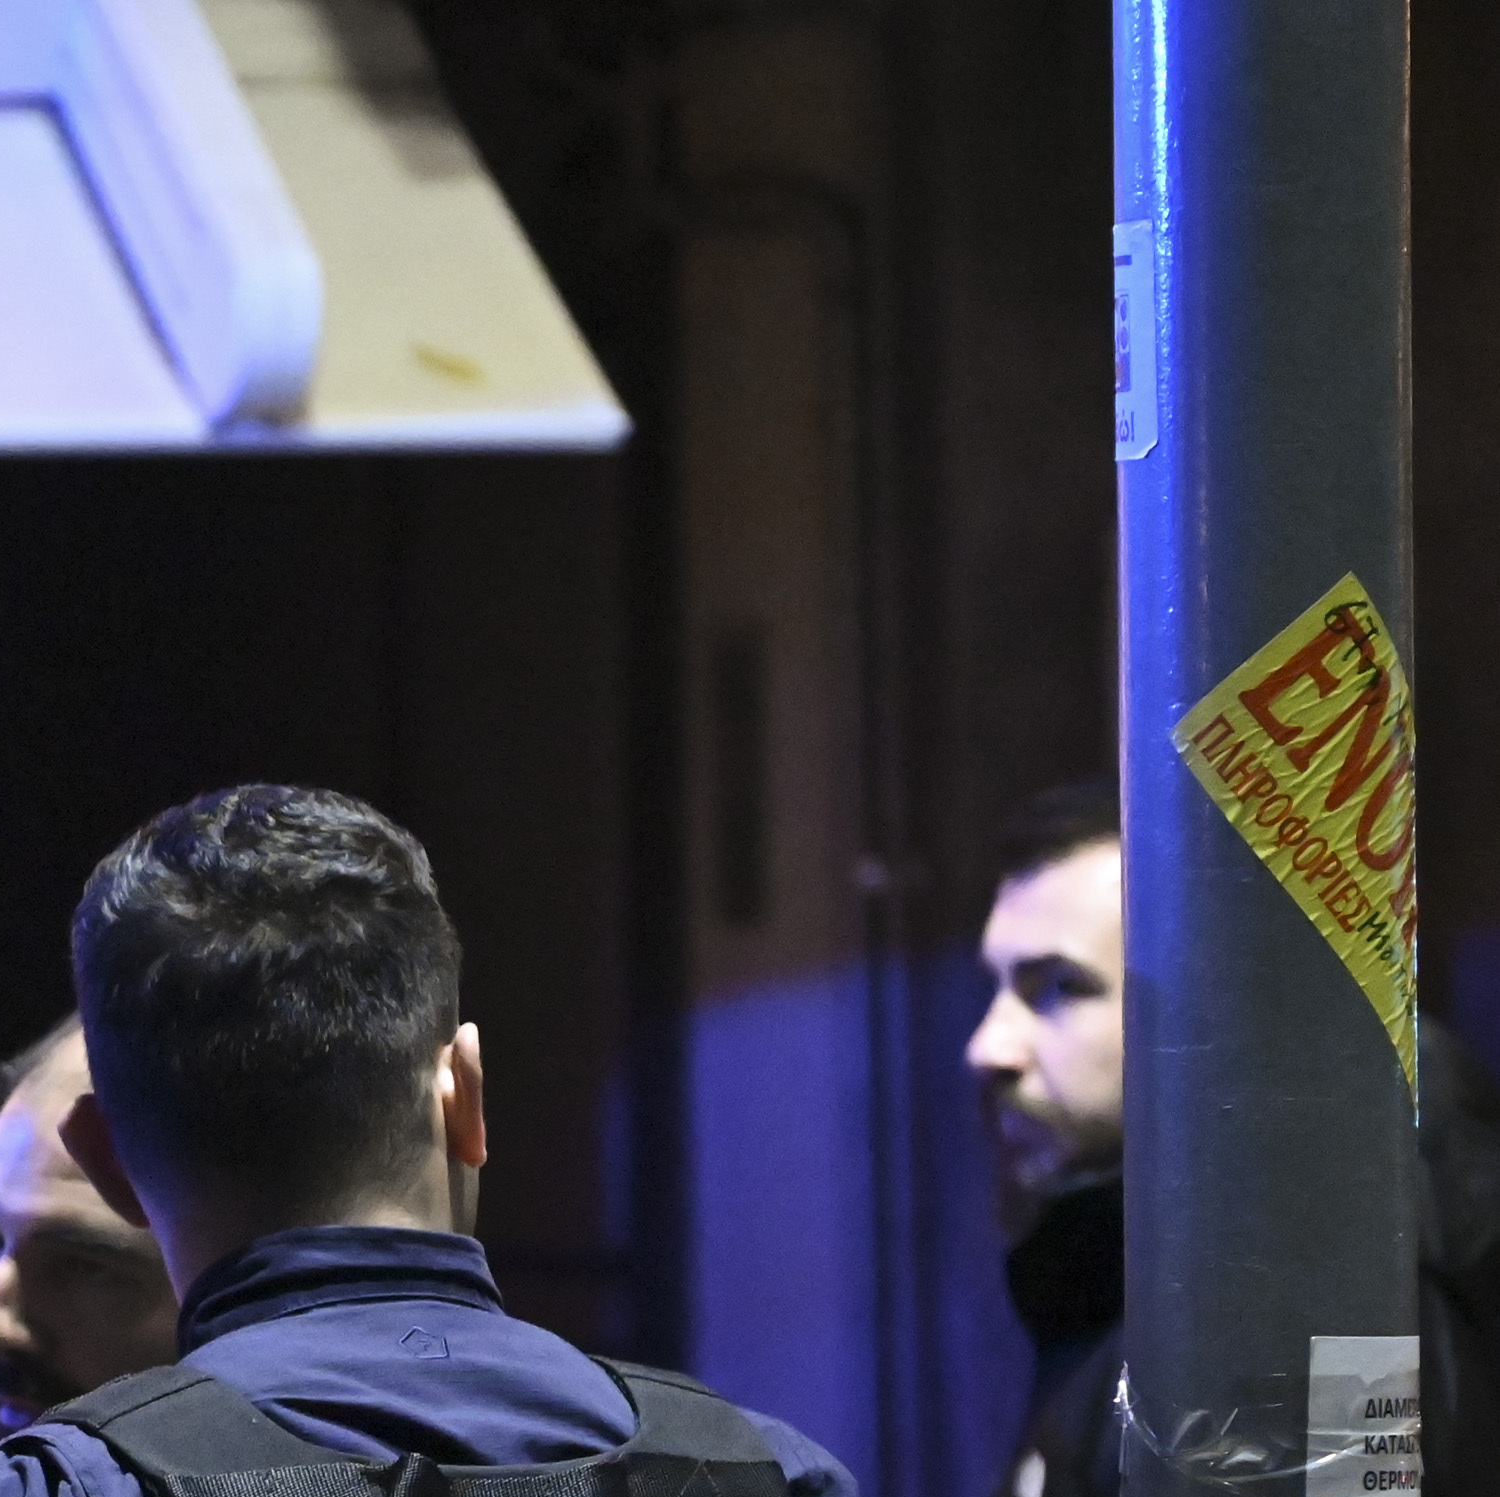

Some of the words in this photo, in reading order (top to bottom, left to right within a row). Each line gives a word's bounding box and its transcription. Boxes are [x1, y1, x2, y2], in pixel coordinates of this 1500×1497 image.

[1192, 712, 1373, 933] ΠΛΗΡΟΦΟΡΙΕΣ
[1364, 1397, 1420, 1419] ΔΙΑΜΕ
[1364, 1434, 1420, 1455] ΚΑΤΑΣ
[1363, 1470, 1419, 1491] ΘΕΡΜΟ
